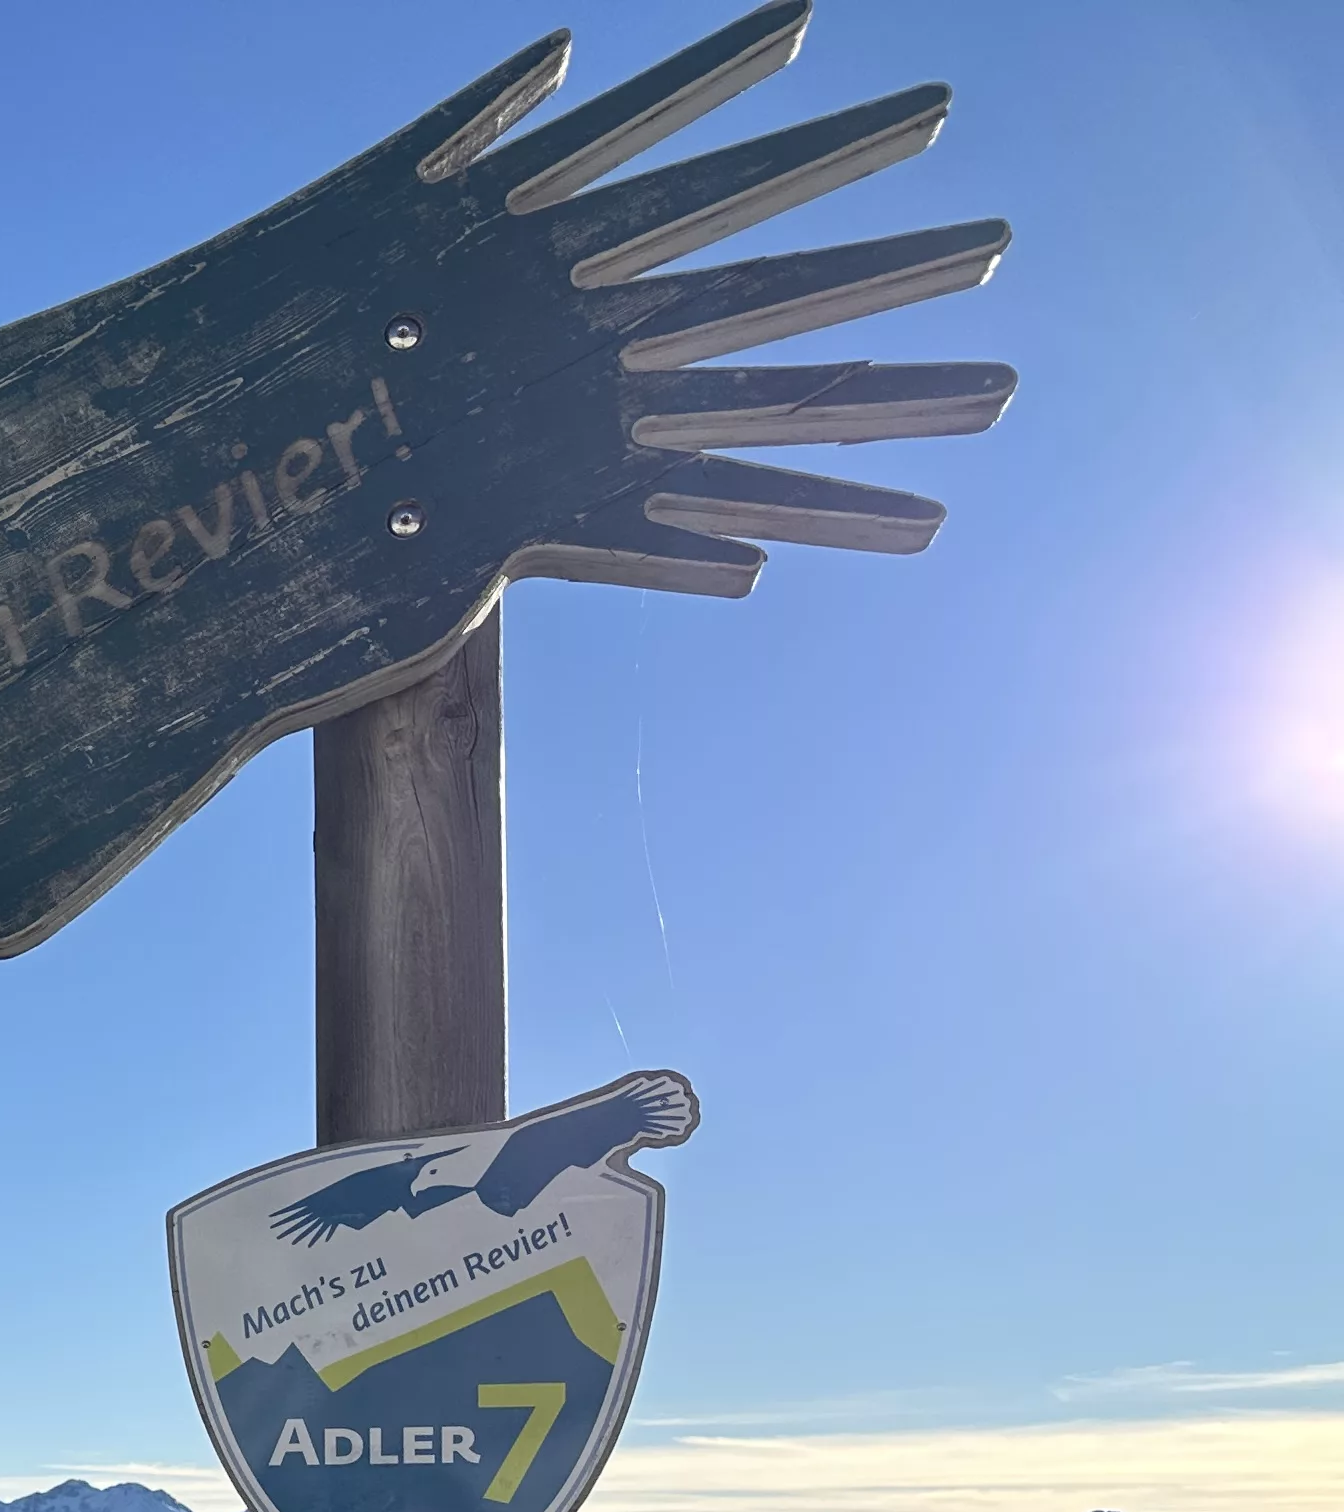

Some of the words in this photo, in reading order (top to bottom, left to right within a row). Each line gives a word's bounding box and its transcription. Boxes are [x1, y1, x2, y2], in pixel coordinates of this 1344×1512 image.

[46, 375, 414, 640] Revier!
[242, 1273, 345, 1339] Mach's
[351, 1257, 388, 1290] zu
[351, 1268, 458, 1332] deinem
[462, 1212, 573, 1281] Revier!
[477, 1381, 566, 1504] 7
